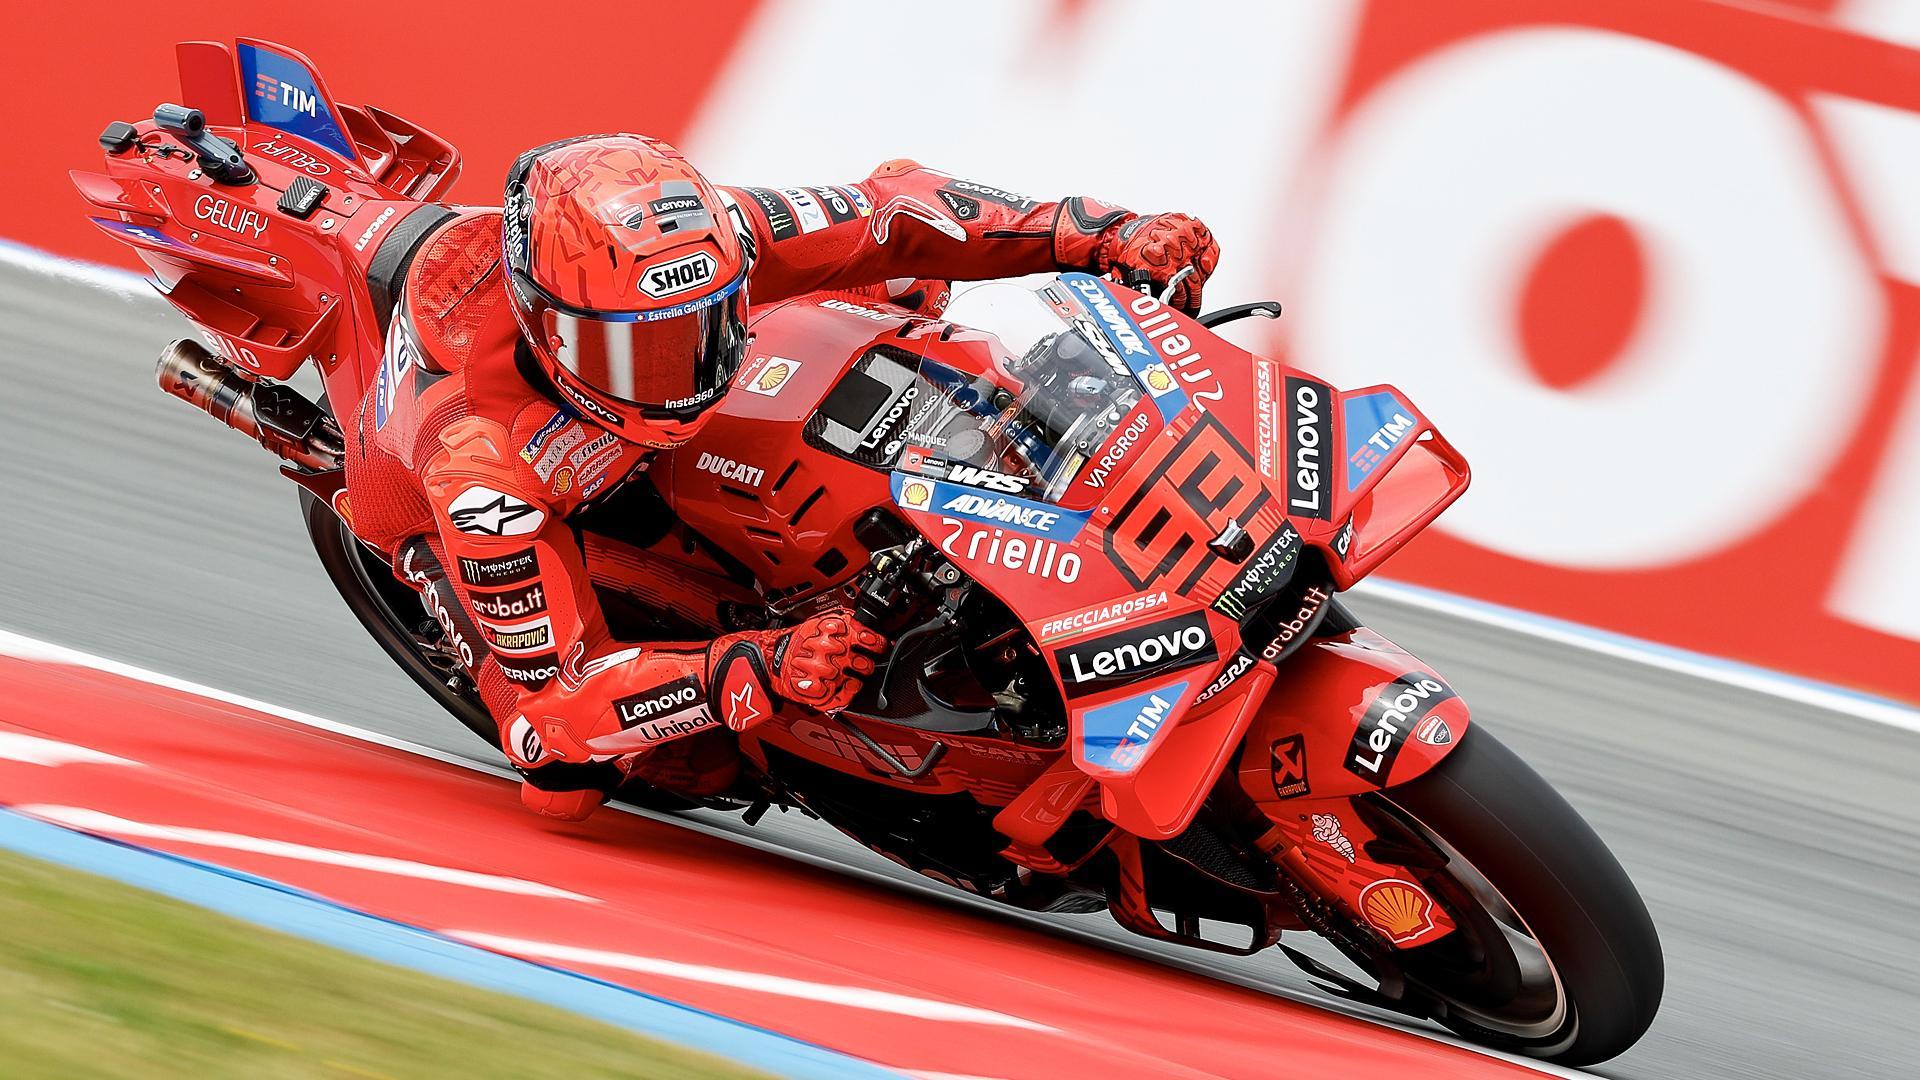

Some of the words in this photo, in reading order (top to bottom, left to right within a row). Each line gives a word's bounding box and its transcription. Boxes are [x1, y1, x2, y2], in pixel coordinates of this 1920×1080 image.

[280, 81, 317, 118] TIM
[253, 140, 331, 176] GELLIFY
[194, 194, 269, 239] GELLIFY
[653, 198, 697, 213] Lenovo
[955, 182, 1031, 209] Lenovo
[355, 207, 396, 252] DUCATI
[508, 192, 524, 258] Estrella
[650, 258, 710, 292] SHOEI
[648, 307, 683, 321] Estrella
[684, 298, 712, 314] Galicia
[817, 299, 893, 322] DUCATI
[1070, 278, 1152, 357] ADVANCE
[1073, 318, 1132, 377] WRS
[1130, 295, 1214, 384] riello
[557, 375, 618, 422] Lenovo
[665, 387, 714, 409] Insta360
[860, 385, 920, 449] Lenovo
[898, 395, 939, 440] motorola
[1257, 361, 1272, 478] FRECCIAROSSA
[908, 432, 947, 447] MARQUEZ
[1083, 412, 1151, 489] VARGROUP
[1291, 385, 1320, 511] Lenovo
[1368, 413, 1414, 451] TIM
[696, 451, 765, 487] DUCATI
[923, 457, 945, 467] Lenovo
[948, 464, 1030, 494] WRS
[583, 476, 605, 500] SAP
[942, 494, 1060, 532] ADVANCE
[480, 555, 533, 574] MONSTER
[967, 528, 1082, 584] riello
[1233, 527, 1299, 598] MONSTER
[1257, 547, 1298, 595] ENERGY
[471, 587, 543, 617] aruba.it
[1041, 591, 1168, 637] FRECCIAROSSA
[1261, 586, 1329, 660] aruba.it
[1069, 626, 1207, 683] Lenovo
[620, 686, 698, 722] Lenovo
[639, 708, 714, 741] Unipol
[1126, 694, 1171, 740] TIM
[1355, 679, 1443, 773] Lenovo
